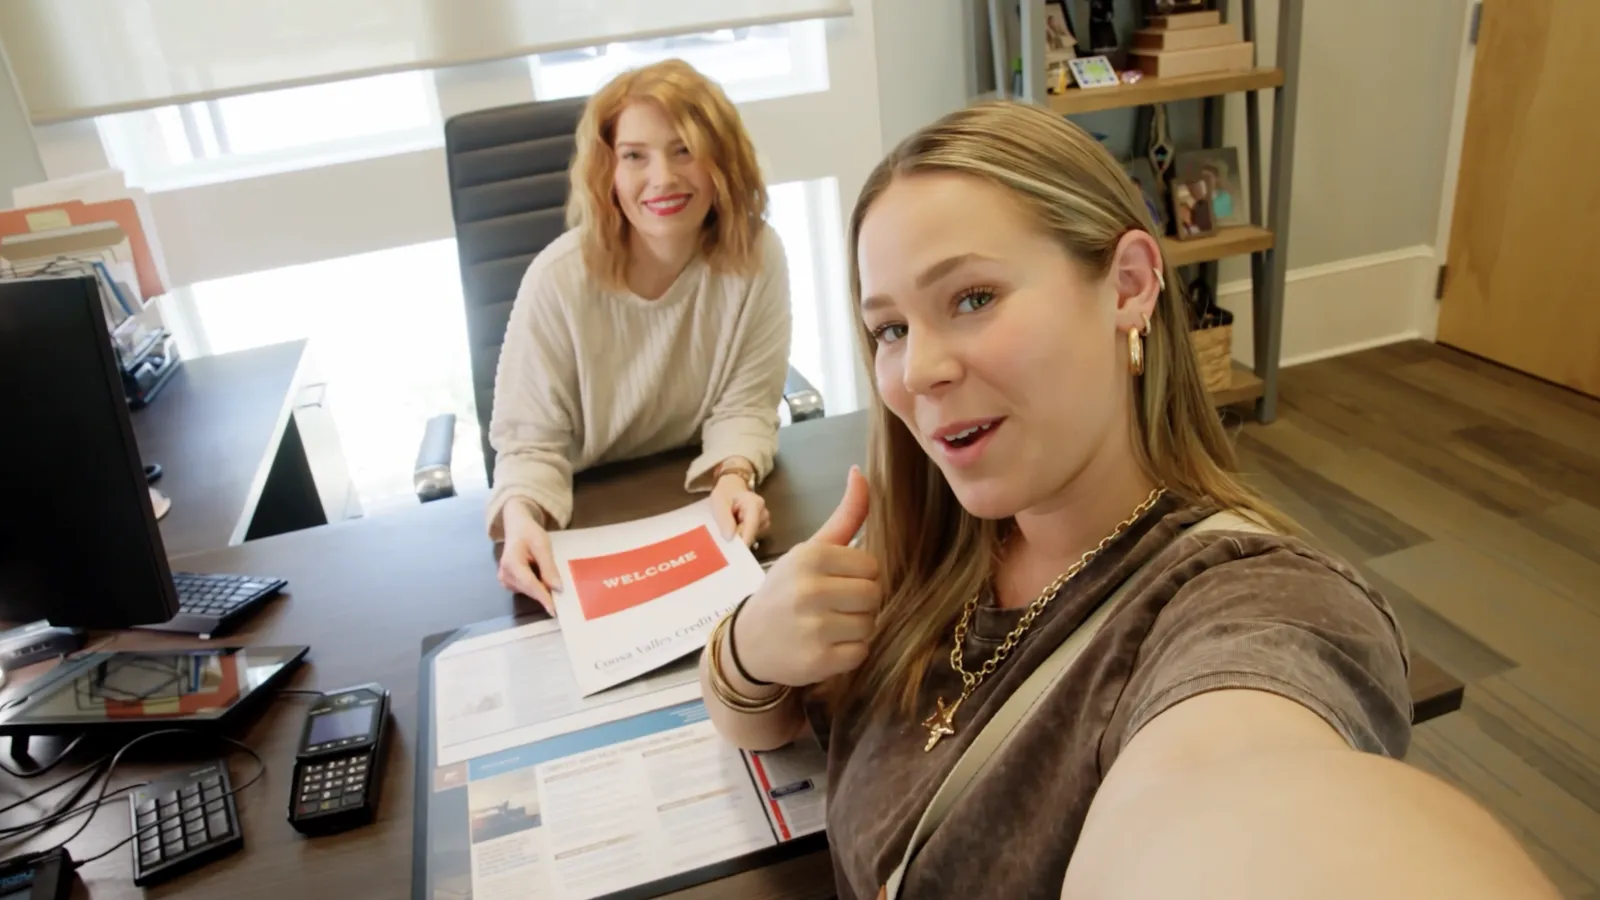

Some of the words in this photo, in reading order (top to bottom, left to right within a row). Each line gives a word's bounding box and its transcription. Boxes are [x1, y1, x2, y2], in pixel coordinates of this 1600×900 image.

[602, 550, 697, 589] WELCOME
[594, 651, 633, 671] Coosa
[635, 636, 672, 655] Valley
[674, 615, 713, 638] Credit
